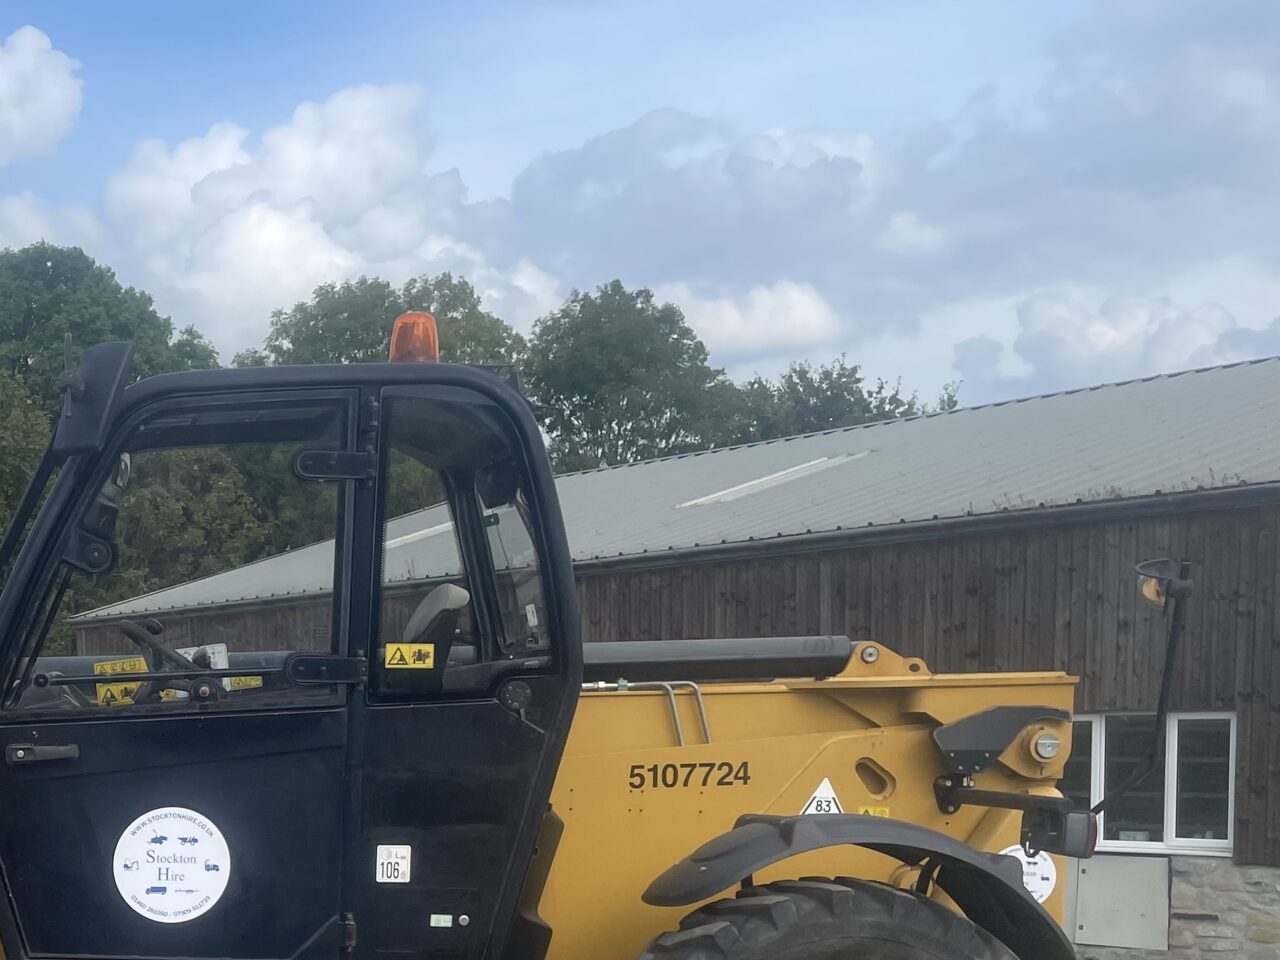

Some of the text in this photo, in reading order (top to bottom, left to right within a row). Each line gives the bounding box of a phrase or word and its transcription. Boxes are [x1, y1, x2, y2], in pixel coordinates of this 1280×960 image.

[628, 761, 751, 789] 5107724
[815, 800, 831, 813] 83
[146, 849, 197, 864] Stockton
[157, 867, 185, 881] Hire
[380, 861, 400, 879] 106
